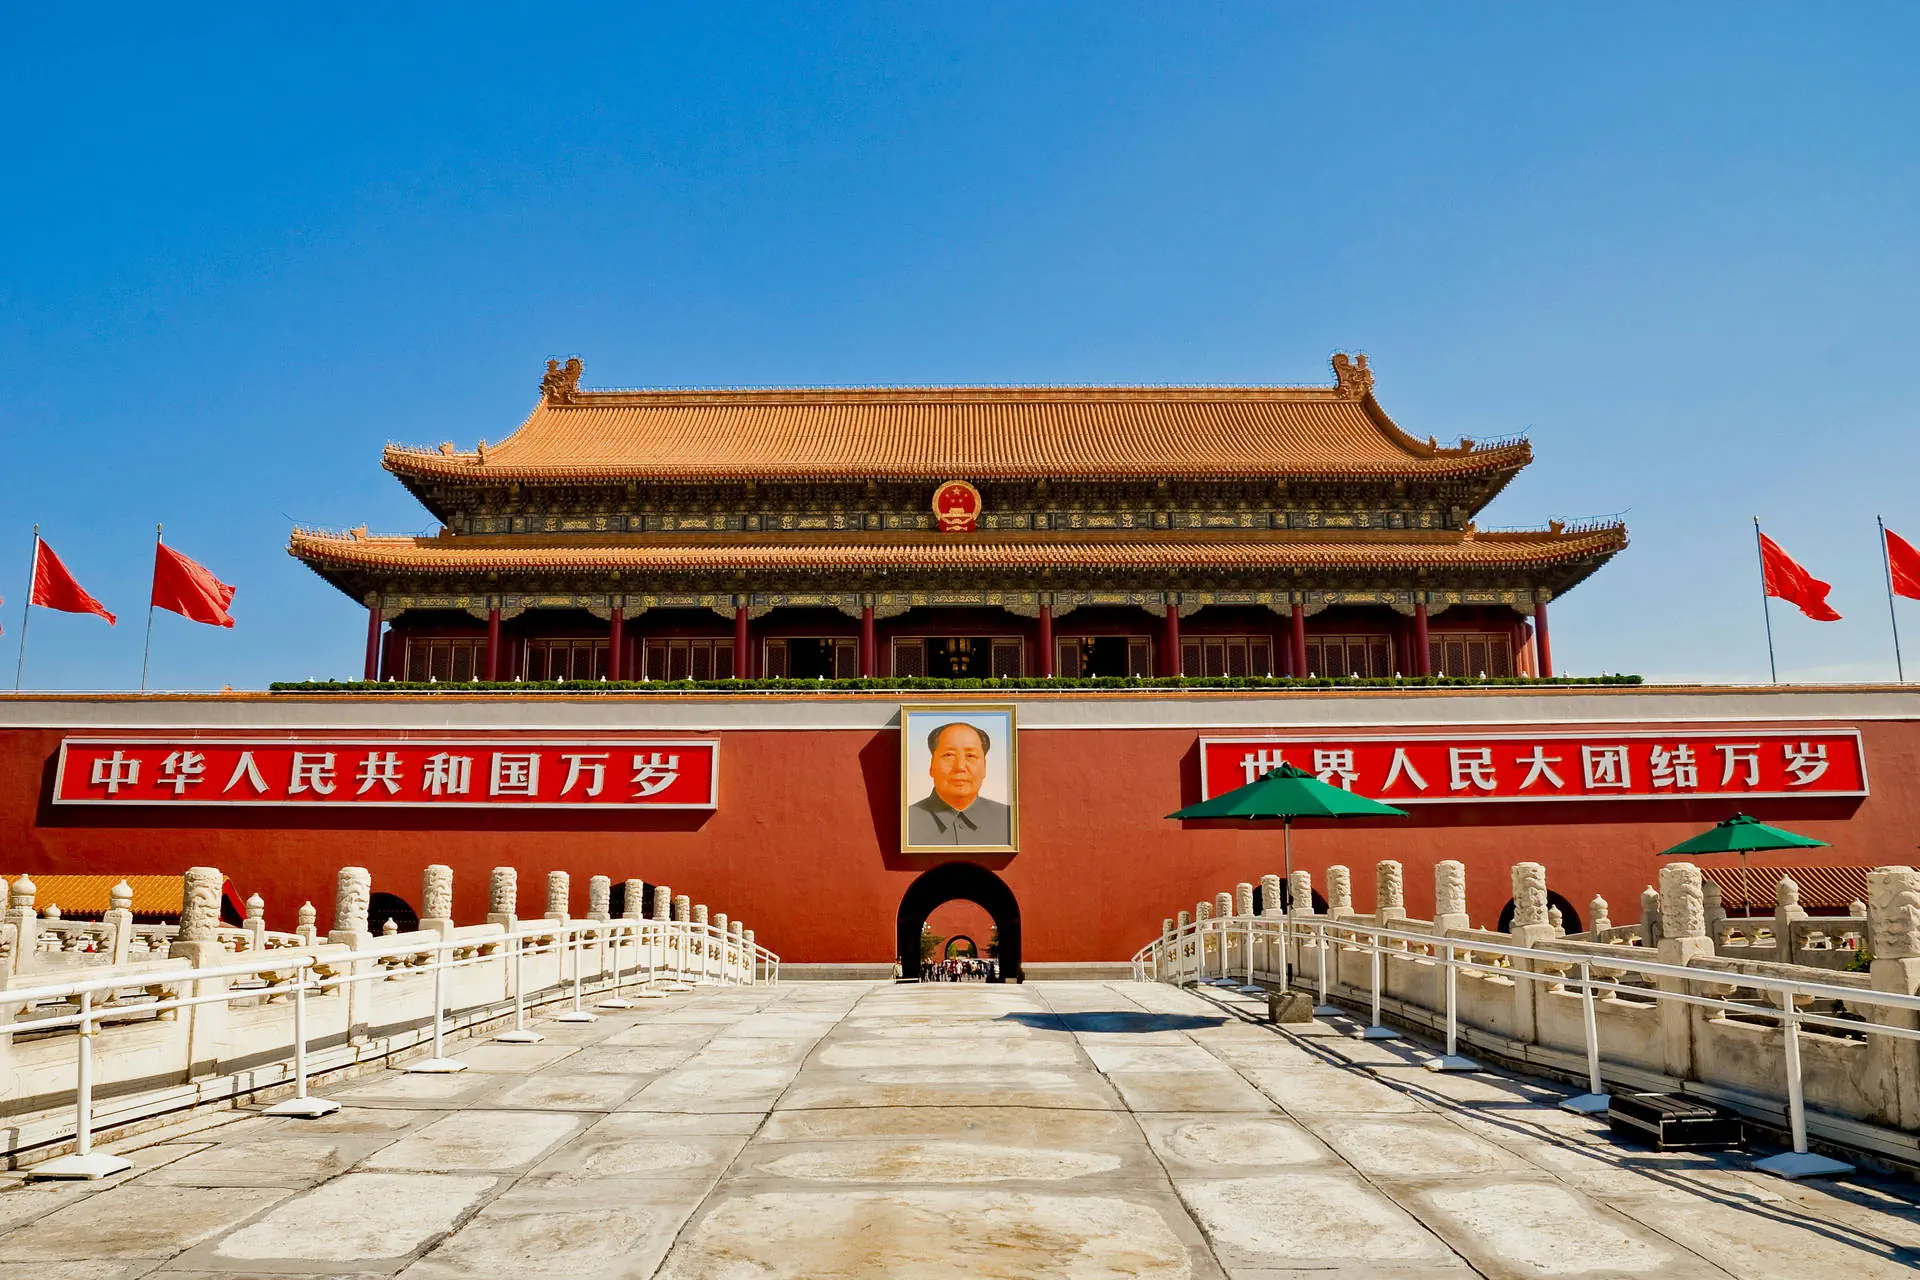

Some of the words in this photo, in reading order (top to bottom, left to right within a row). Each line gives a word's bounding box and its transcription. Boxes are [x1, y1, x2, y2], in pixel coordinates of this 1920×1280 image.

[91, 750, 680, 797] 中华人民共和国万岁
